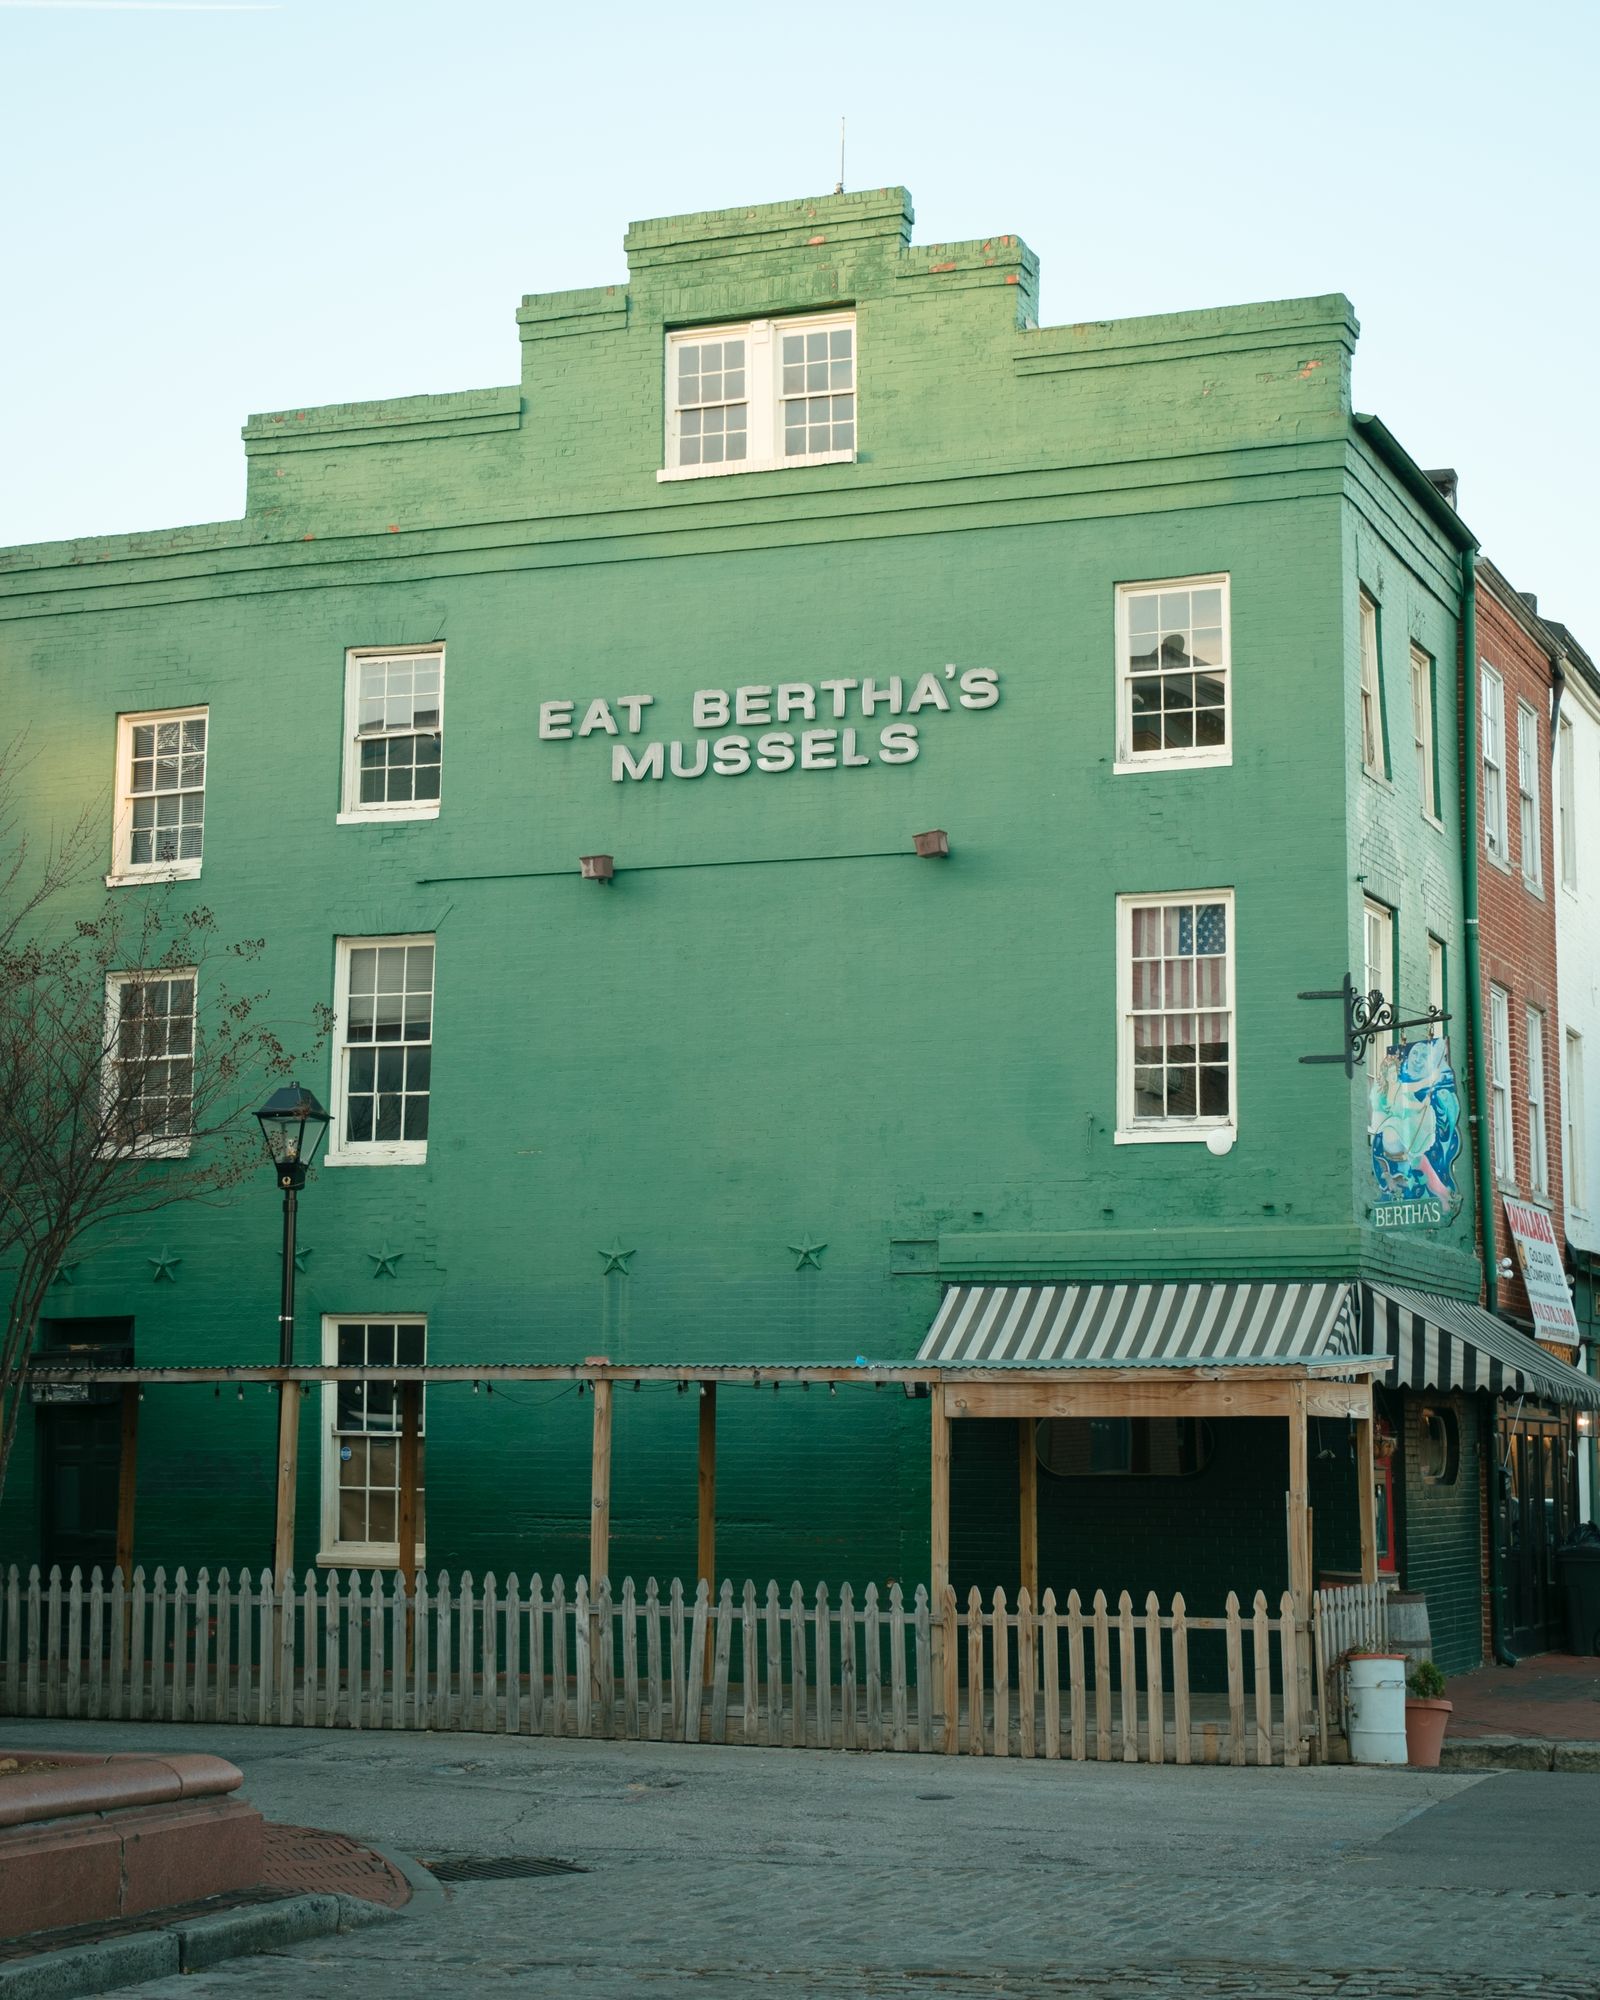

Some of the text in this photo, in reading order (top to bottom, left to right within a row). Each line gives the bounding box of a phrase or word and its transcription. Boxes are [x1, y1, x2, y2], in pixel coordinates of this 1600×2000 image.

[539, 664, 1000, 740] EAT BERTHA'S
[612, 723, 920, 782] MUSSELS
[1375, 1202, 1440, 1227] BERTHA'S
[1505, 1201, 1554, 1244] AVAILABLE
